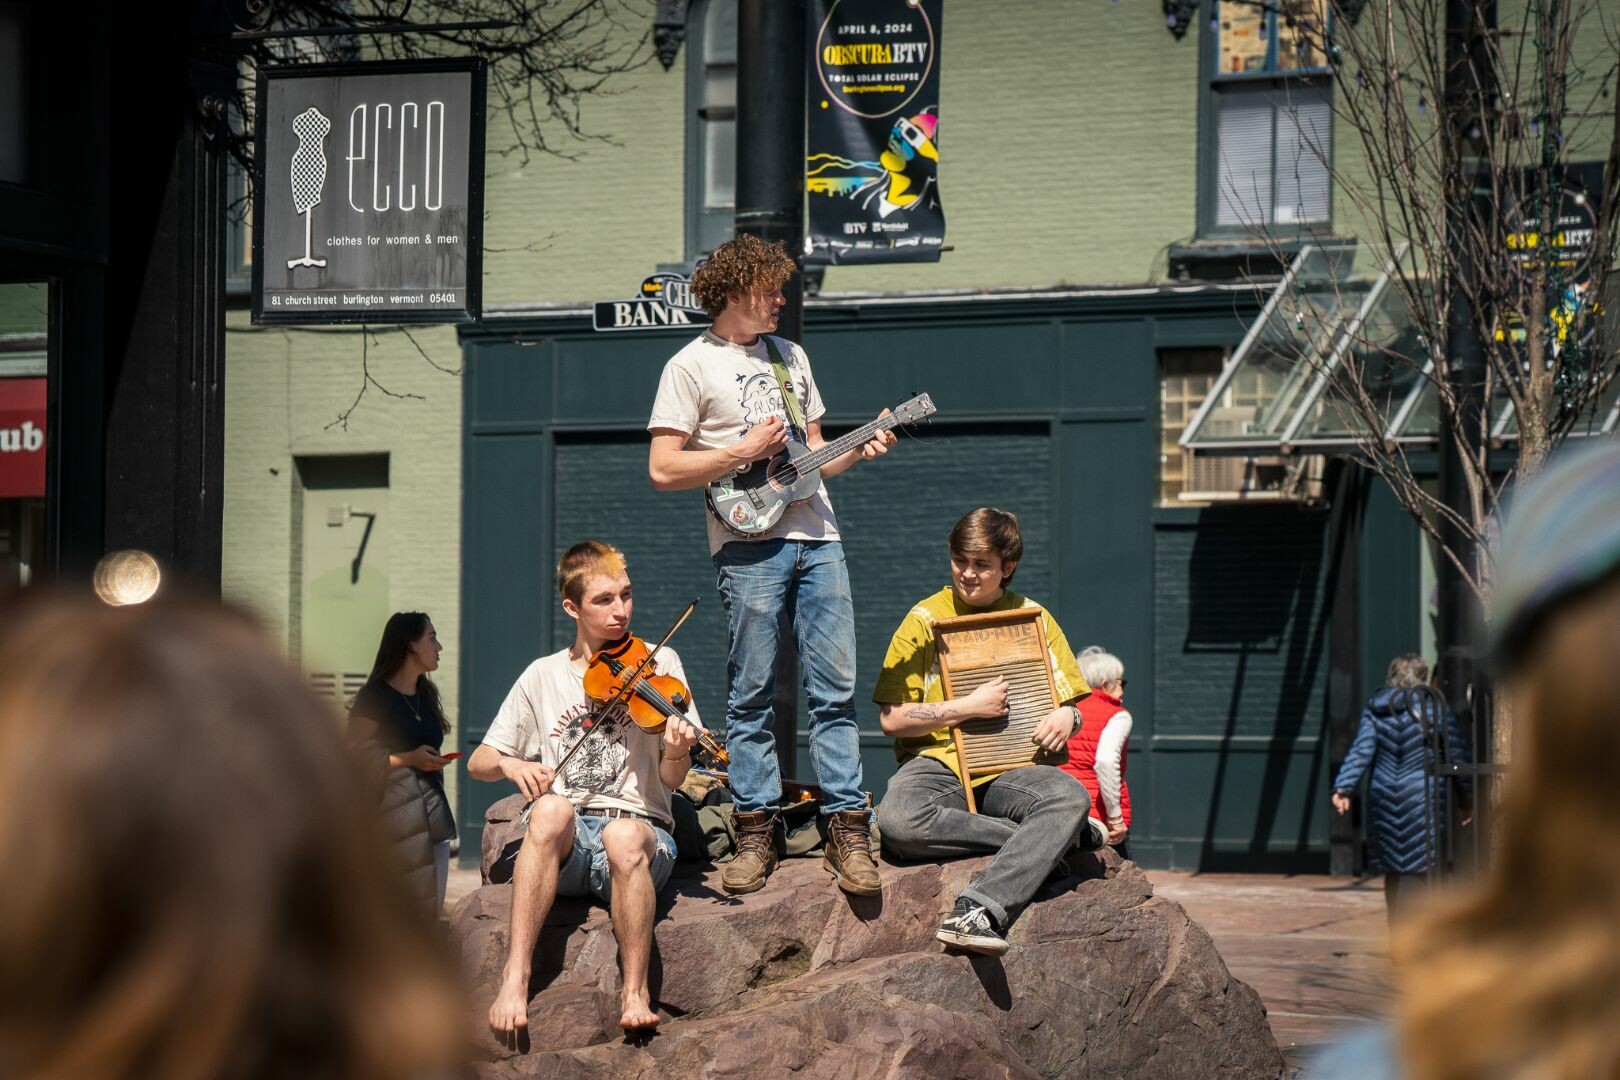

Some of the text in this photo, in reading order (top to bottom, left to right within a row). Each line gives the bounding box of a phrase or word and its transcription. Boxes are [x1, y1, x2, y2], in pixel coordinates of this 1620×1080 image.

[838, 23, 913, 35] APRIL 8, 2024
[828, 72, 919, 83] TOTAL SOLAR ECLIPSE
[327, 234, 458, 247] clothes for women & men
[271, 293, 456, 307] 81 church street burlington vermont 05401
[613, 301, 692, 327] BANK
